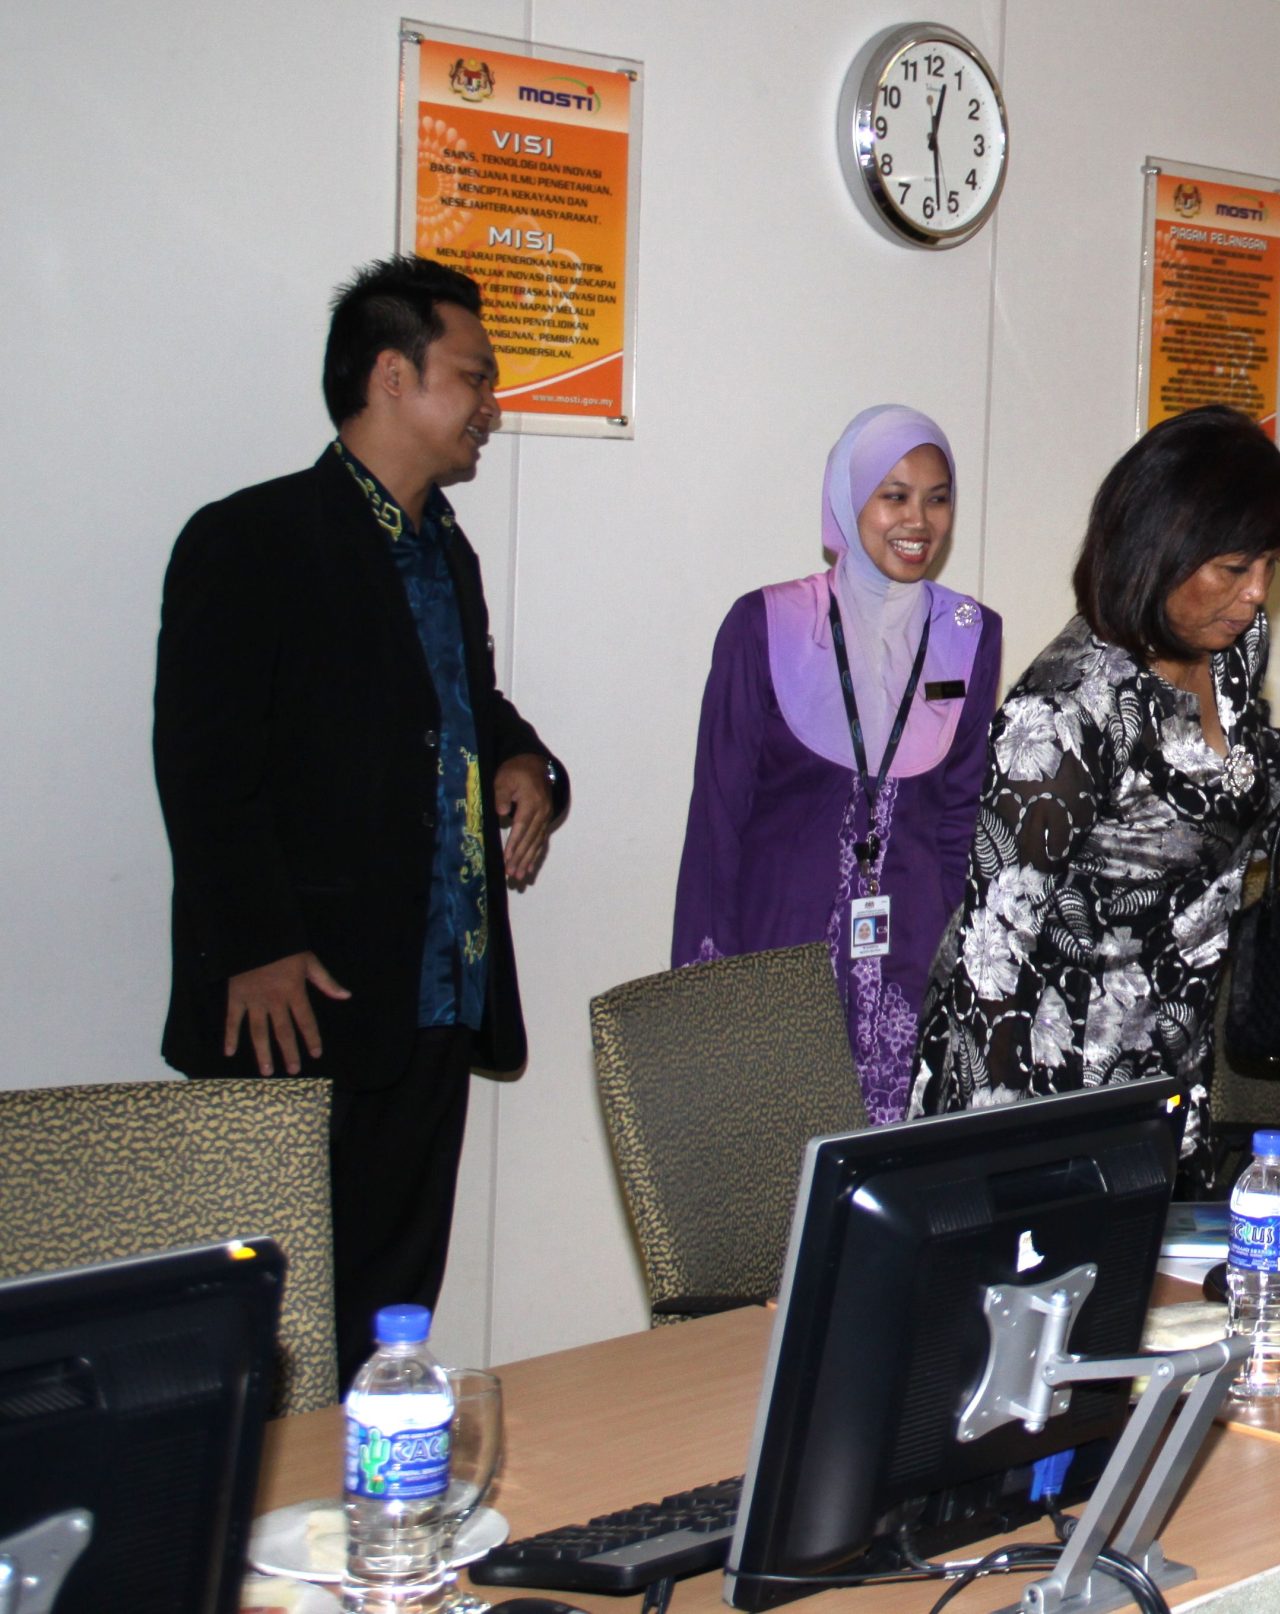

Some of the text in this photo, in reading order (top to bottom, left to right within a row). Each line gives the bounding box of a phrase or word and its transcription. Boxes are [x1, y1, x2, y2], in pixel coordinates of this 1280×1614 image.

[901, 60, 918, 82] 11
[924, 54, 945, 77] 12
[954, 70, 963, 91] 1
[518, 85, 593, 112] MOSTI
[881, 85, 901, 109] 10
[968, 99, 981, 121] 2
[875, 116, 888, 139] 9
[492, 129, 553, 157] VISI
[973, 134, 985, 157] 3
[430, 162, 456, 174] BAGI
[458, 166, 509, 181] MENJANA
[511, 174, 537, 186] ILMU
[482, 153, 538, 170] TEKNOLOGI
[539, 161, 561, 173] DAN
[562, 165, 602, 179] INOVASI
[880, 154, 893, 176] 8
[965, 169, 978, 191] 4
[457, 182, 588, 208] MENCIPTA KEKAYAAN DAN
[898, 182, 911, 205] 7
[947, 191, 960, 213] 5
[441, 196, 529, 215] KESEJAHTERAAN
[922, 196, 935, 219] 6
[1216, 203, 1263, 222] MOSTI
[488, 226, 554, 253] MISI
[436, 247, 604, 273] MENJUARAI PENEROKAAN SAINTIFIK
[506, 270, 545, 282] INOVASI
[569, 277, 616, 290] MENCAPAI
[489, 283, 558, 299] BERTERASKAN
[559, 291, 596, 302] INOVASI
[597, 294, 617, 305] DAN
[519, 302, 554, 313] MAPAN
[523, 316, 590, 331] PENYELIDIKAN
[539, 332, 600, 347] PEMBIAYAAN
